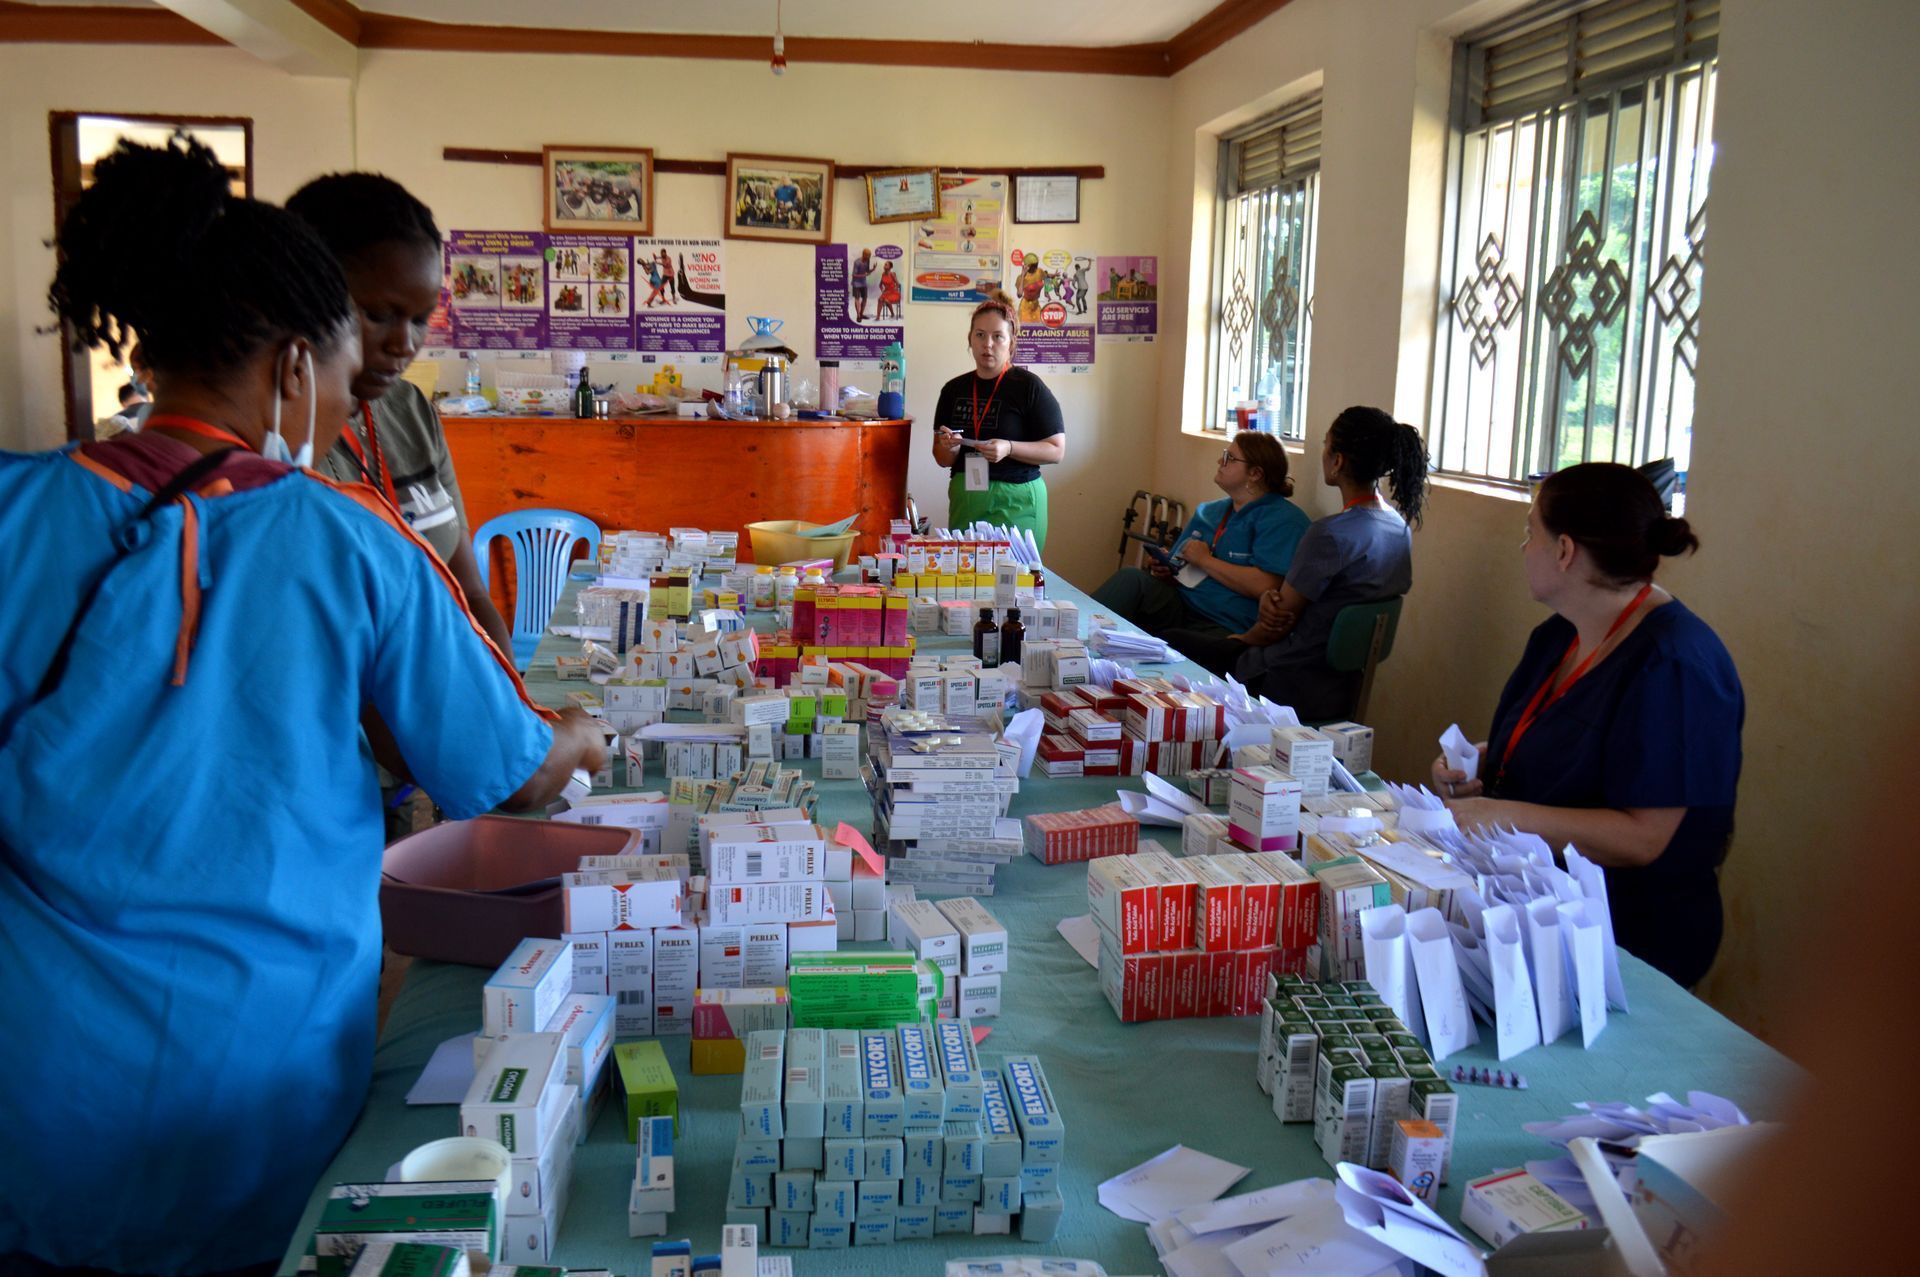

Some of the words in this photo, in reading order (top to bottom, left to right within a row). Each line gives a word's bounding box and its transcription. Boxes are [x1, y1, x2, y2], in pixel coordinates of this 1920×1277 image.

[701, 253, 716, 263] NO
[1044, 312, 1064, 320] STOP
[868, 1038, 888, 1088] ELYCORT
[904, 1028, 927, 1078] ELYCORT
[942, 1024, 967, 1072] ELYCORT
[984, 1081, 1011, 1133] ELYCORT
[1012, 1063, 1045, 1114] ELYCORT
